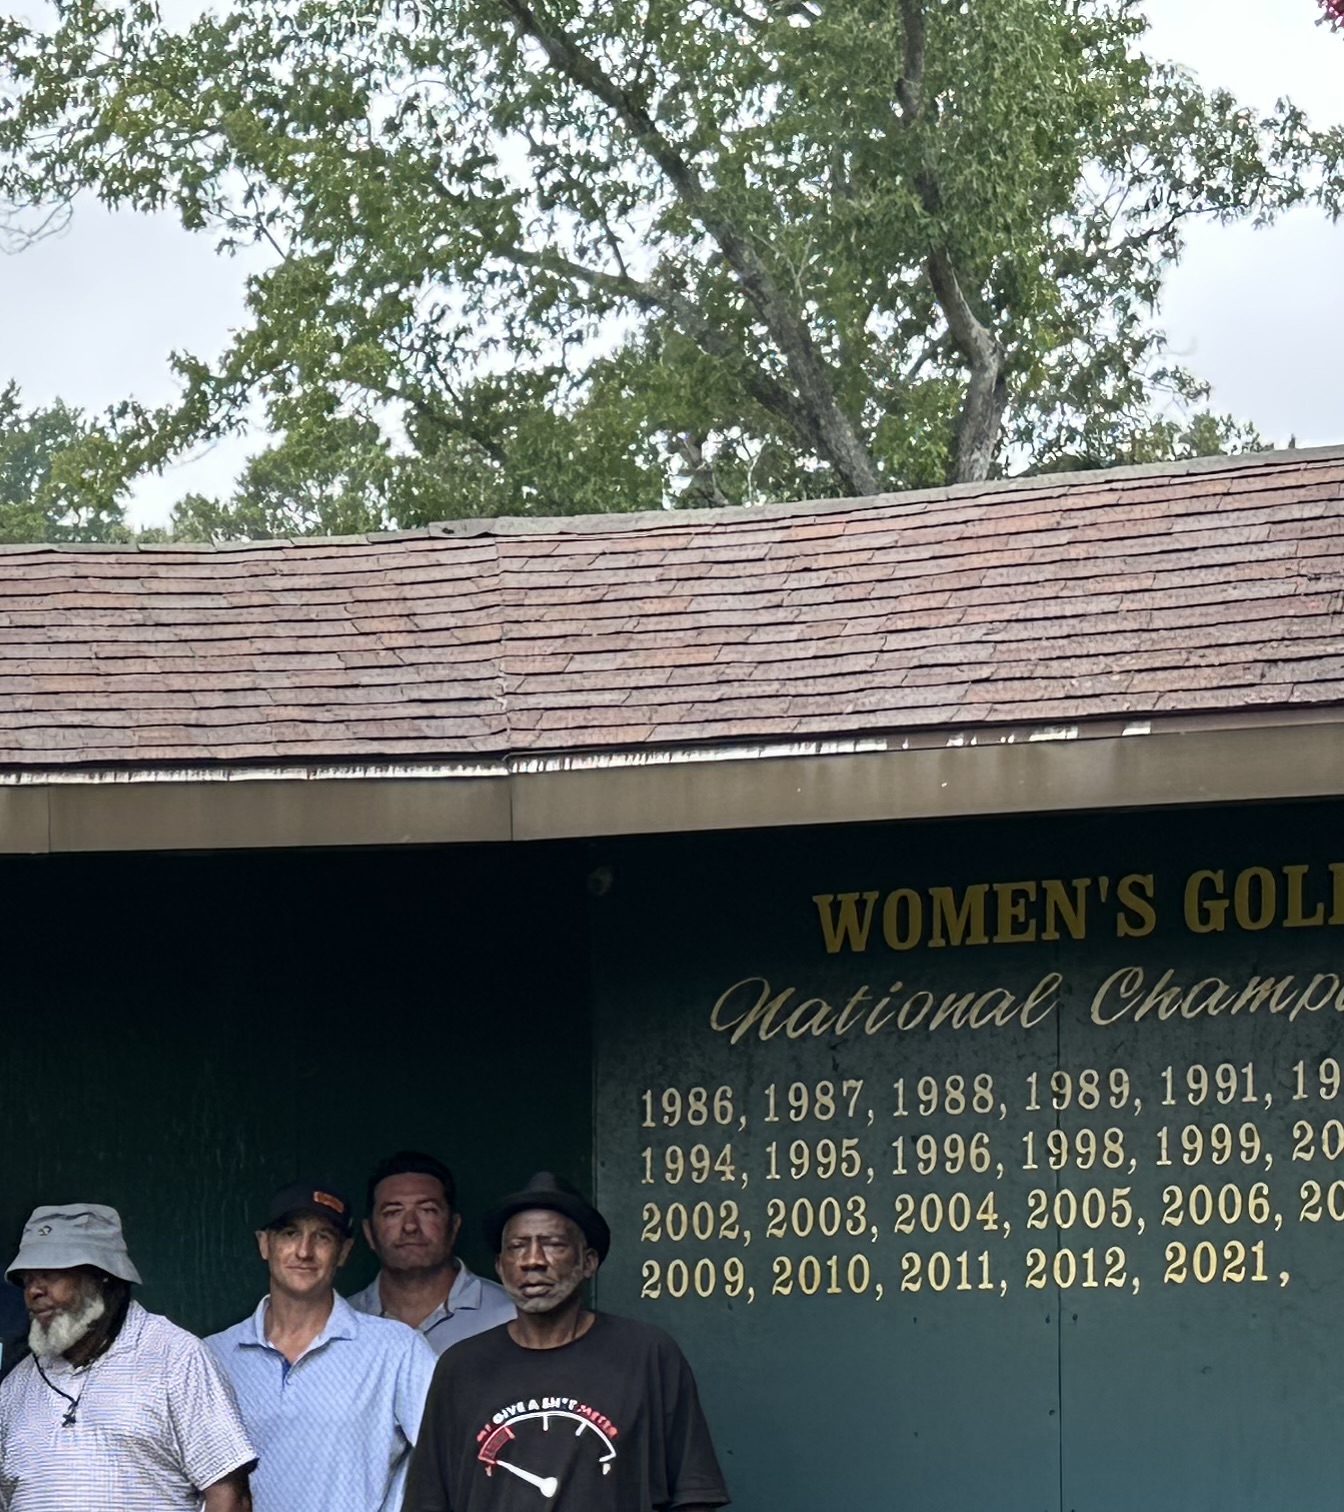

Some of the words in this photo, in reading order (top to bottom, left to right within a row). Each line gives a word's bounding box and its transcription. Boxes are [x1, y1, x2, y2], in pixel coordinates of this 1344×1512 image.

[813, 873, 1157, 953] WOMEN'S
[710, 972, 1063, 1044] National
[641, 1085, 747, 1131] 1986,
[764, 1079, 875, 1126] 1987,
[893, 1073, 1006, 1120] 1988,
[1025, 1068, 1142, 1116] 1989,
[1161, 1062, 1272, 1110] 1991,
[641, 1144, 748, 1189] 1994,
[765, 1138, 875, 1184] 1995,
[892, 1132, 1004, 1179] 1996,
[1022, 1127, 1137, 1174] 1998,
[1157, 1122, 1272, 1171] 1999,
[641, 1200, 751, 1247] 2002,
[766, 1196, 879, 1243] 2003,
[895, 1192, 1011, 1238] 2004,
[1027, 1187, 1145, 1235] 2005,
[1162, 1182, 1283, 1232] 2006,
[641, 1257, 755, 1304] 2009,
[772, 1254, 883, 1301] 2010,
[901, 1251, 1008, 1297] 2011,
[1025, 1247, 1140, 1295] 2012,
[1164, 1240, 1290, 1287] 2021,
[528, 1399, 540, 1411] A
